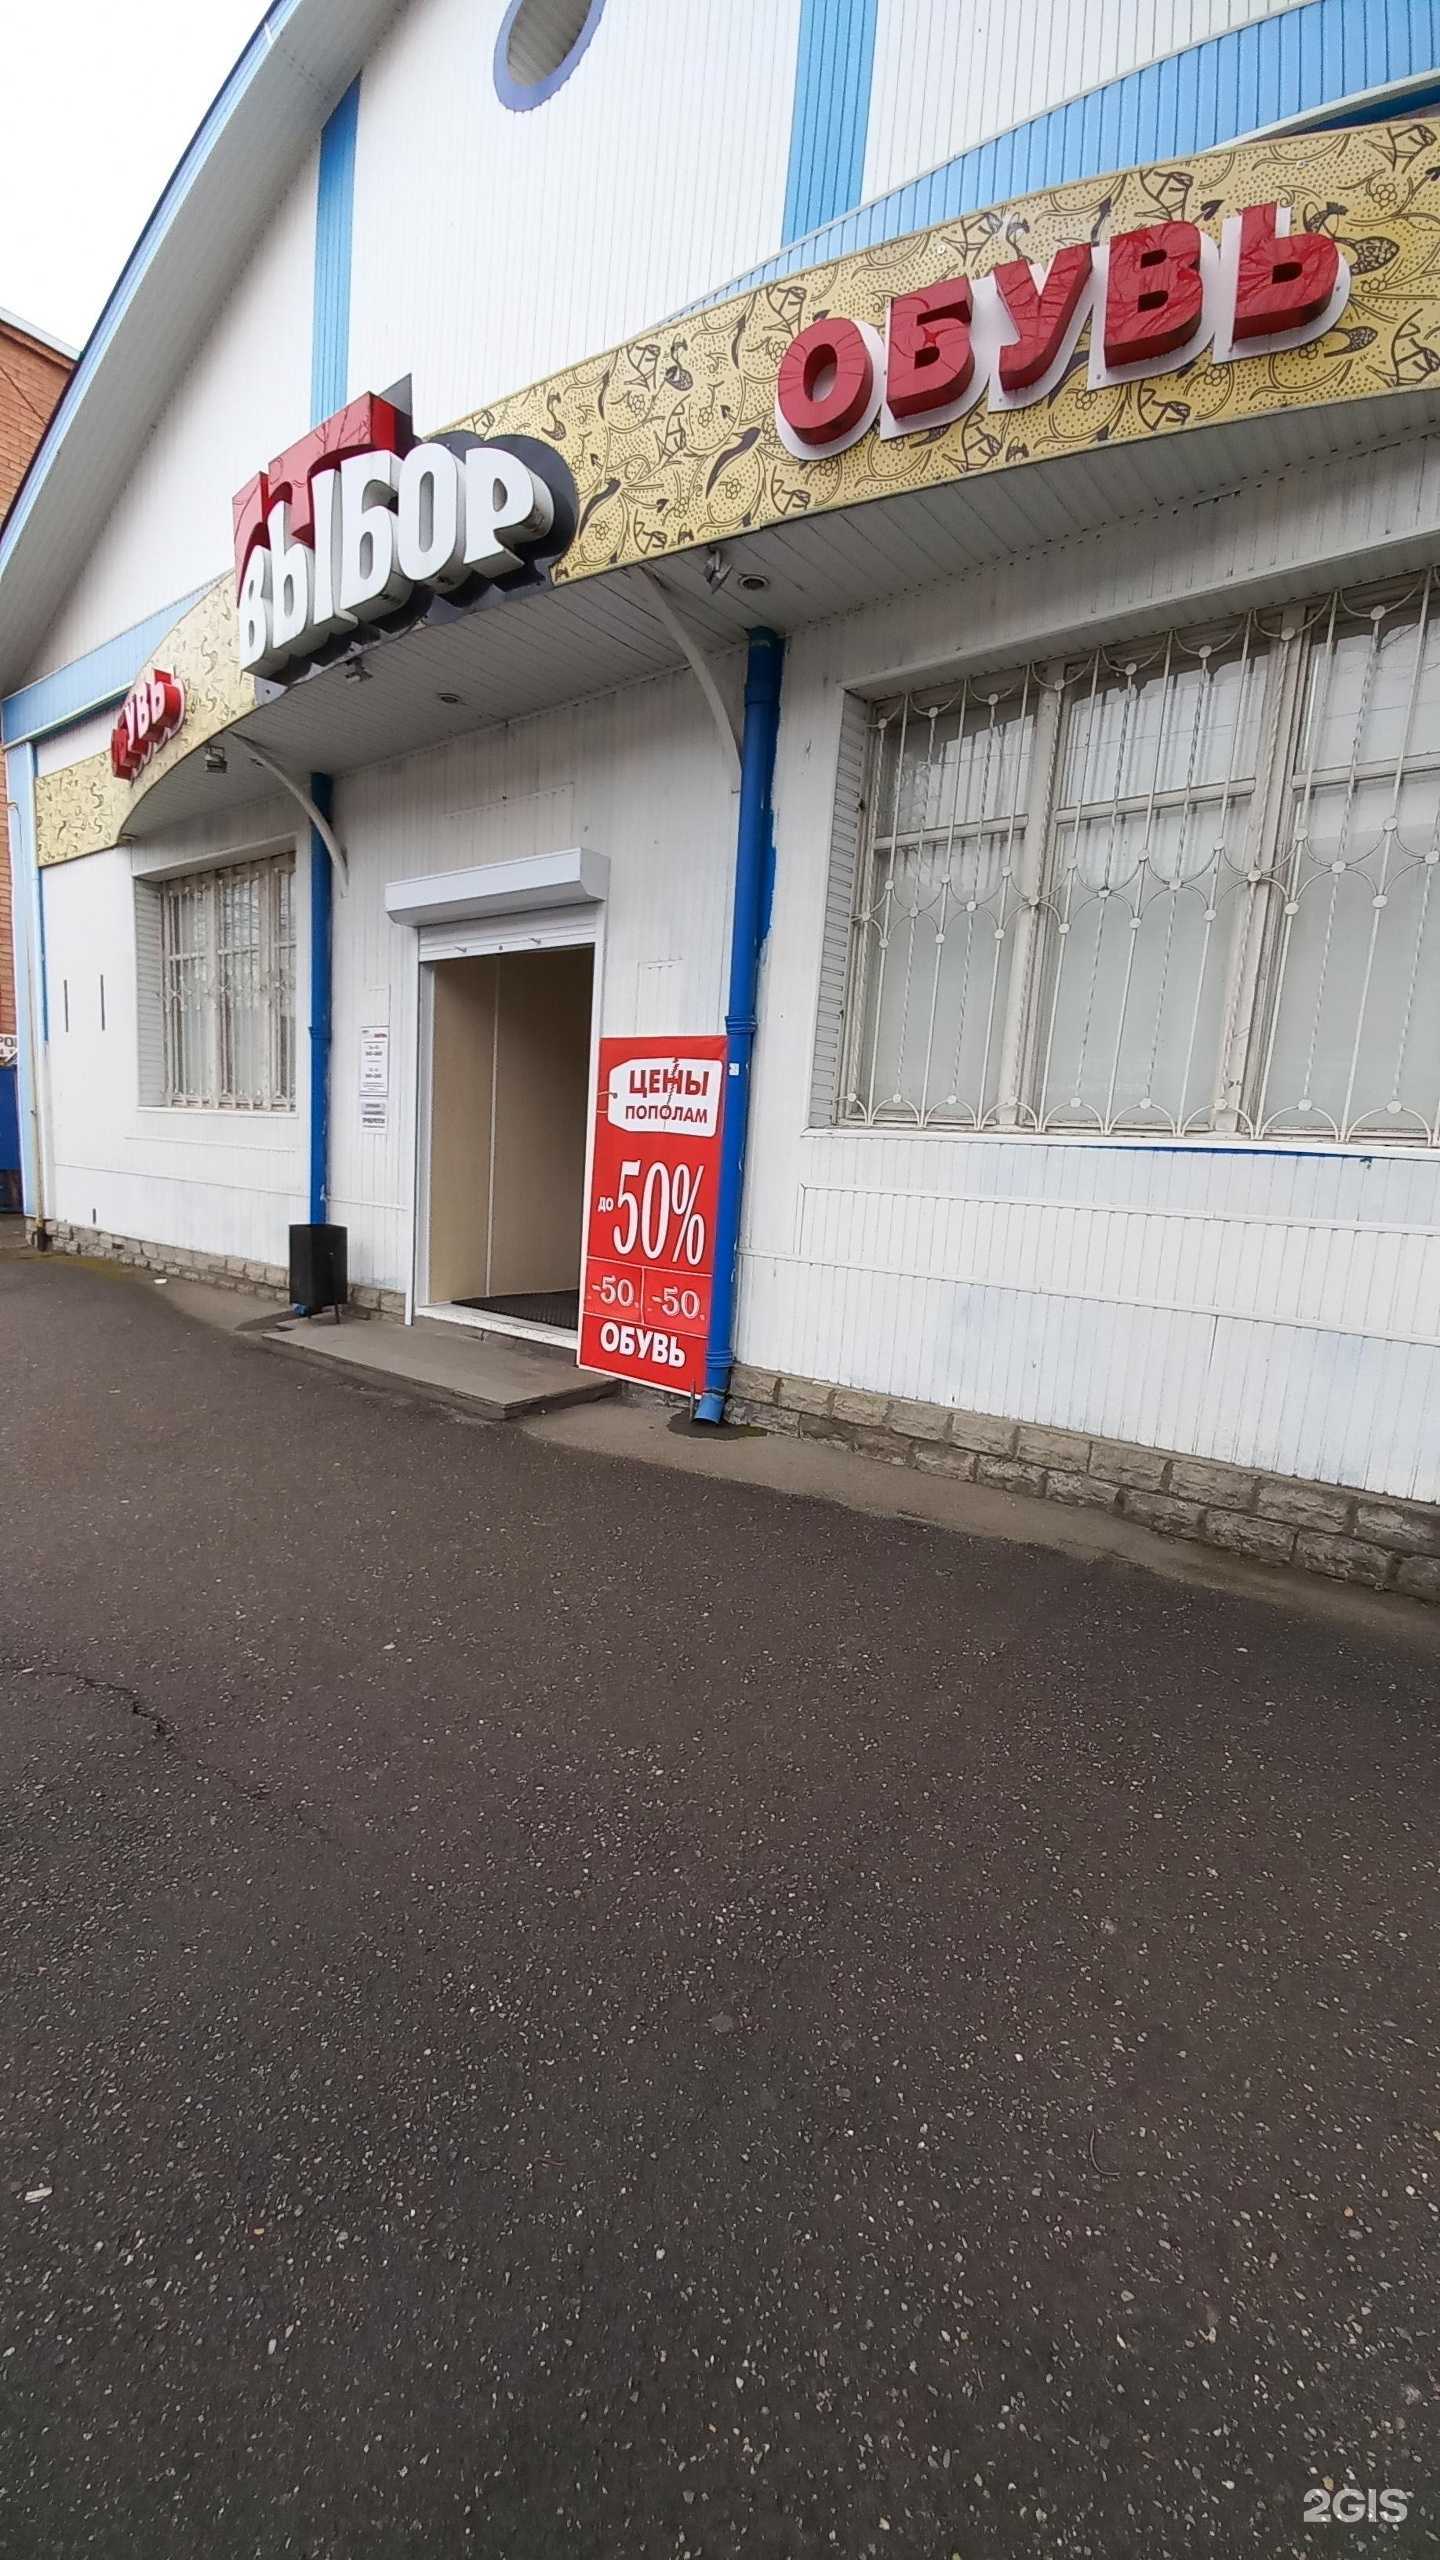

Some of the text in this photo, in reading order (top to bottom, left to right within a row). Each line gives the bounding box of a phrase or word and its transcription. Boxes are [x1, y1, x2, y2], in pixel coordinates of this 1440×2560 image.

[777, 202, 1340, 448] ОБУВЬ
[238, 442, 548, 671] ВЫБОР
[629, 1069, 709, 1098] ЦЕНЫ
[625, 1105, 708, 1123] ПОПОЛАМ
[613, 1159, 705, 1265] 50%
[592, 1274, 635, 1307] -50
[651, 1285, 701, 1320] -50
[600, 1321, 686, 1368] ОБУВЬ
